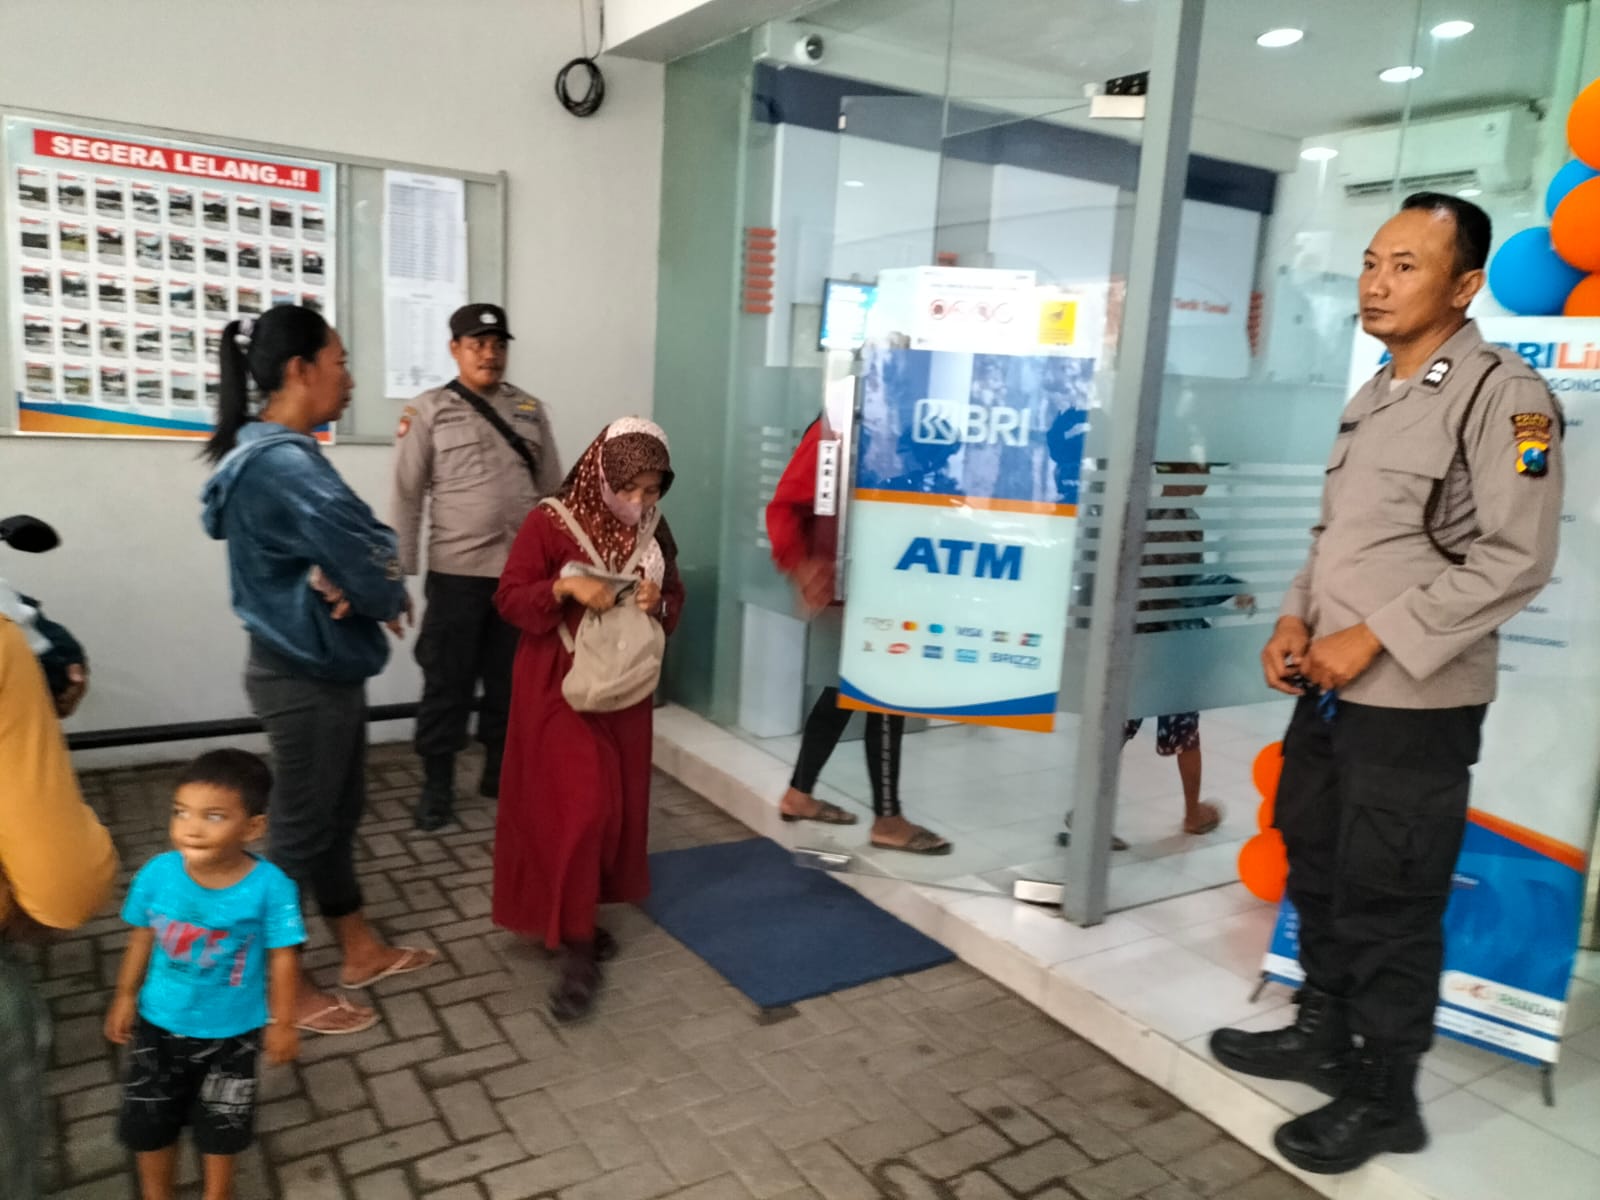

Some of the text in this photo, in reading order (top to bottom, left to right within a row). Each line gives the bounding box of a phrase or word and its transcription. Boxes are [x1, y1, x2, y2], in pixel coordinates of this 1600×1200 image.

[51, 135, 308, 188] SEGERA LELANG..!!
[958, 404, 1031, 447] BRI
[821, 445, 834, 499] TARIK
[894, 536, 1024, 581] ATM
